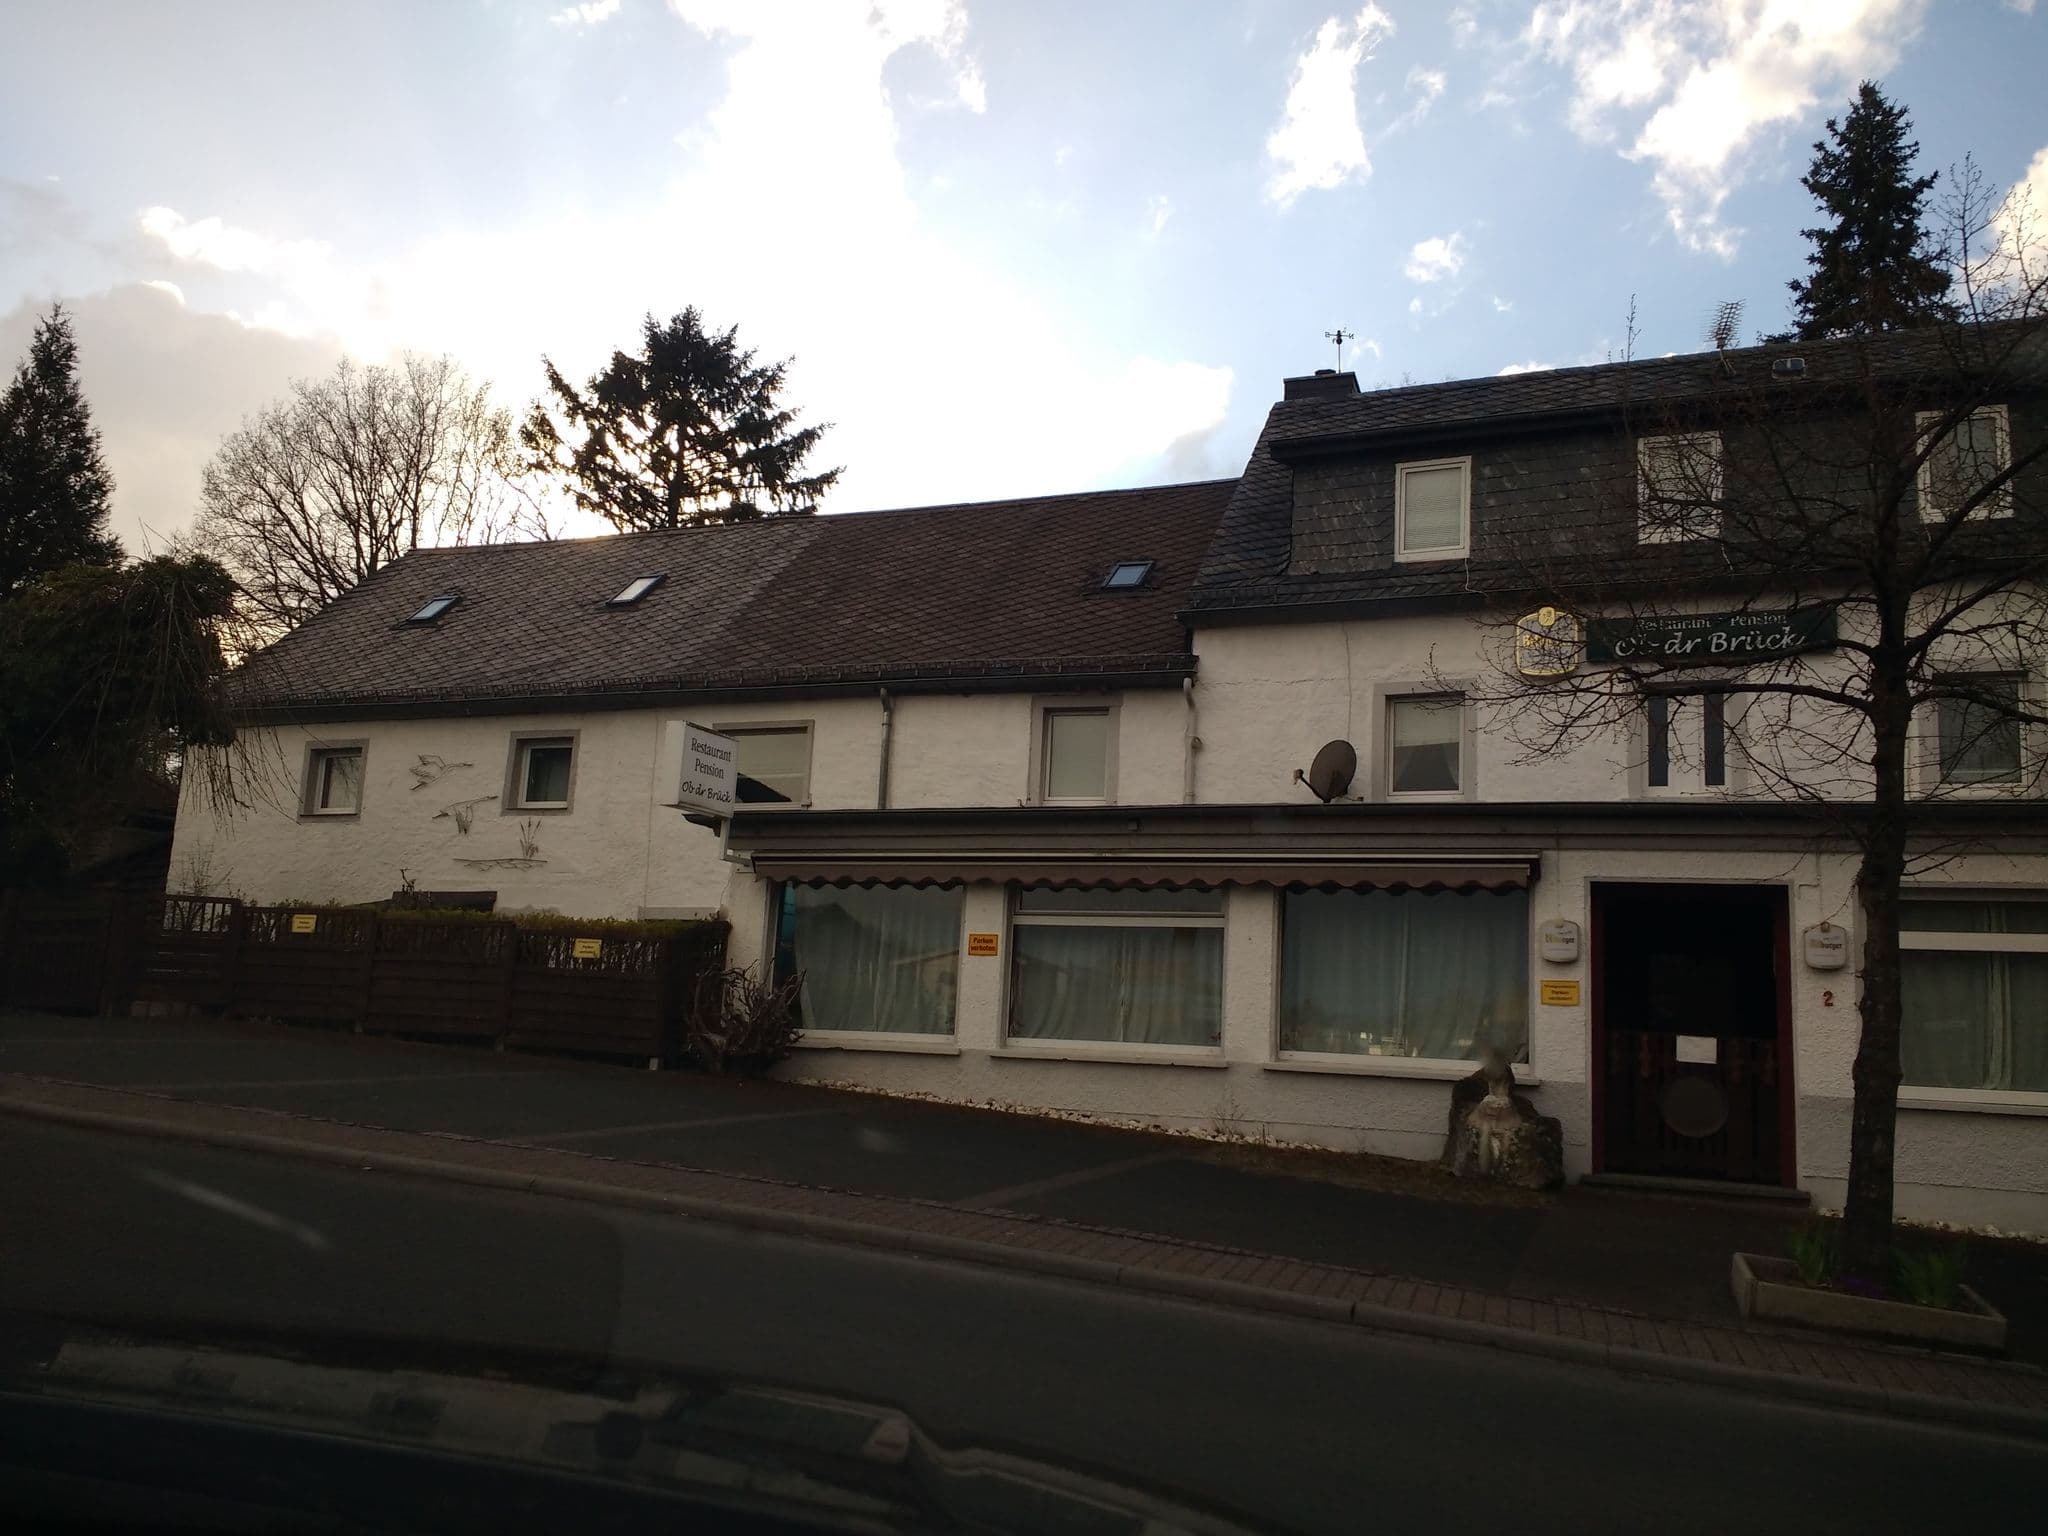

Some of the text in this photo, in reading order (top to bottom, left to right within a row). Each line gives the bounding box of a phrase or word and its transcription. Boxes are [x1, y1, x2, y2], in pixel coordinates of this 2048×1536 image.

[1729, 613, 1788, 627] Pension
[691, 737, 731, 762] Restaurant
[694, 758, 724, 779] Pension
[1823, 990, 1833, 1006] 2
